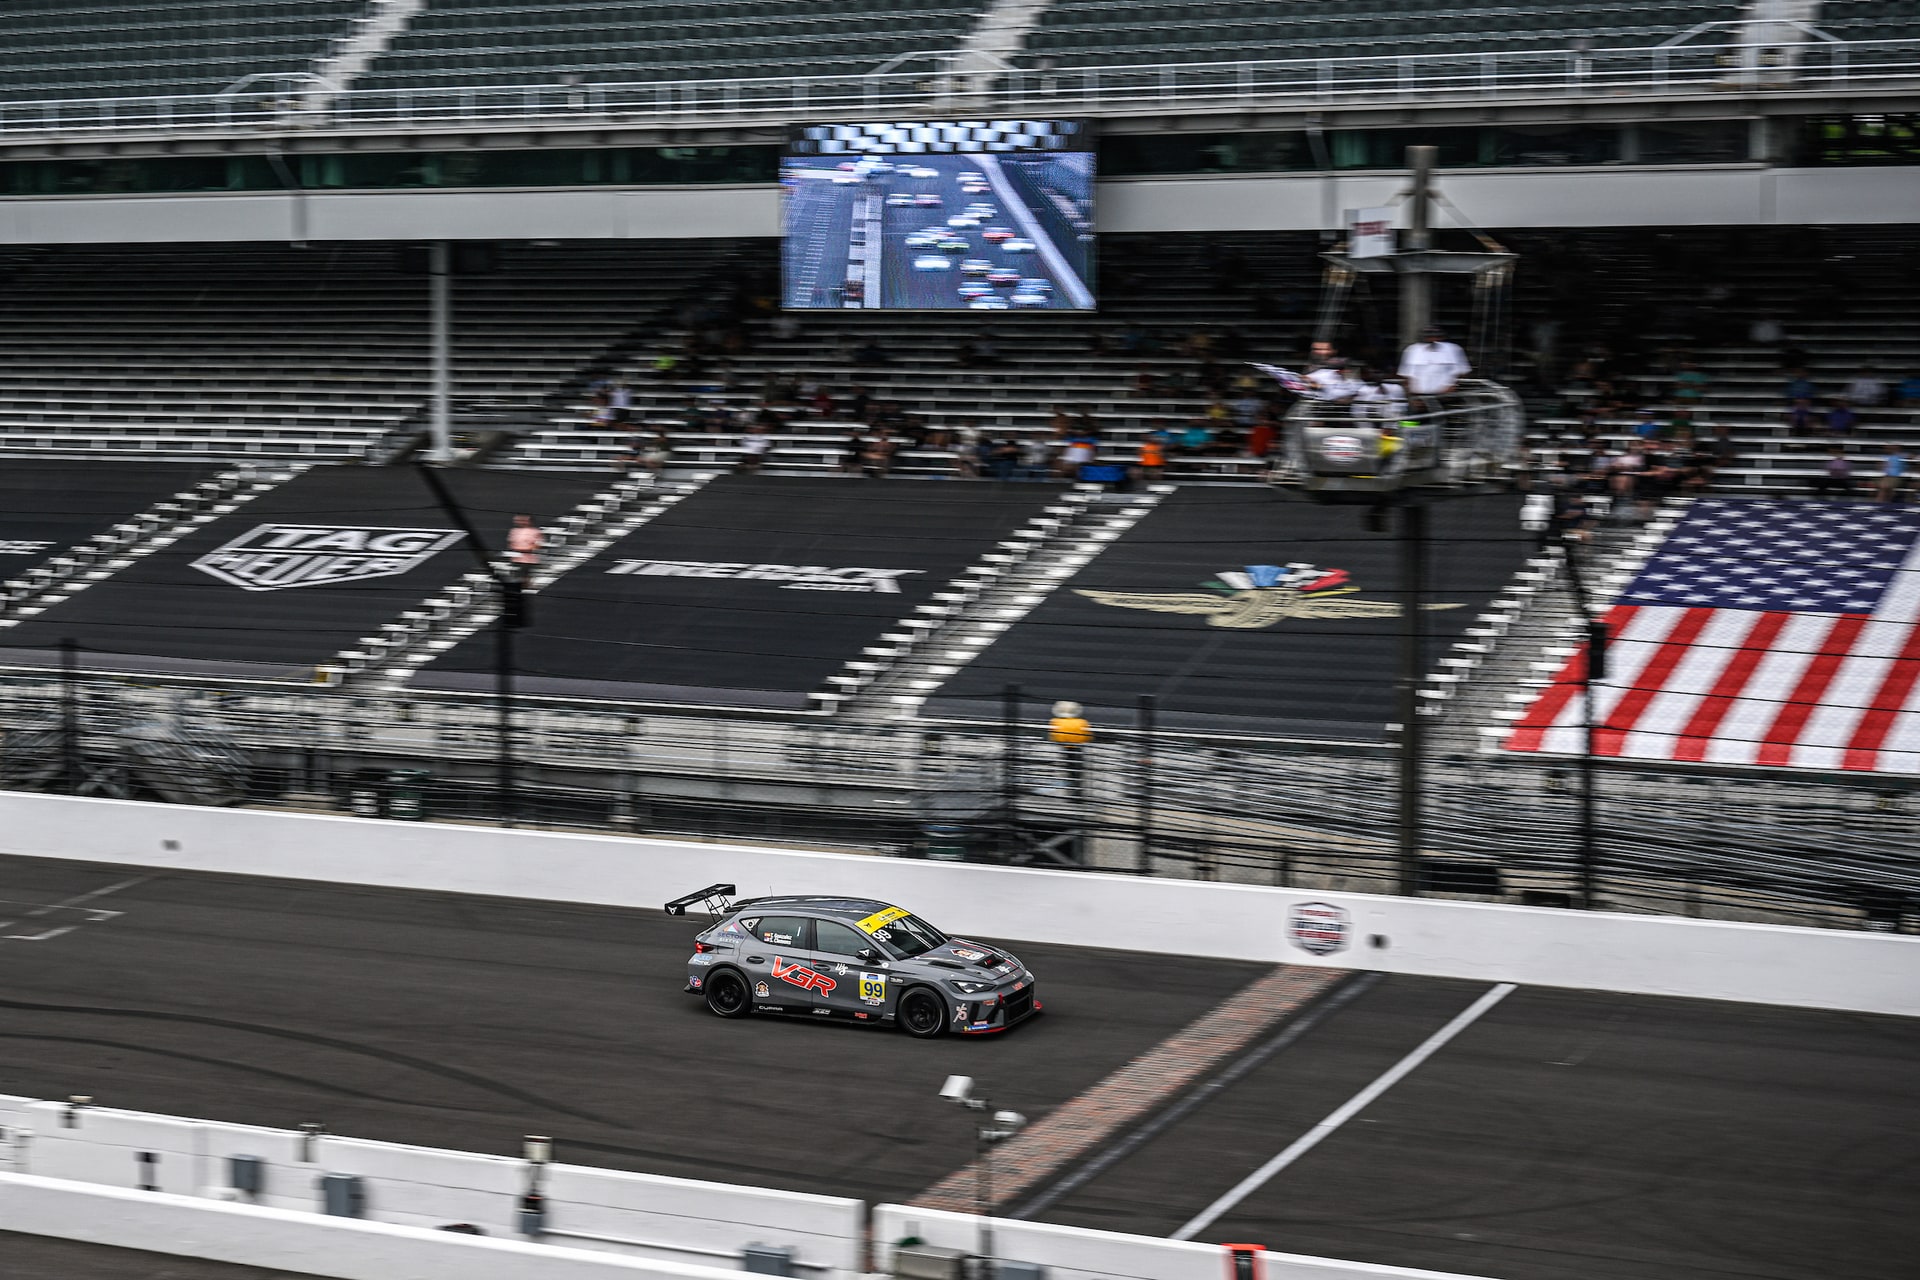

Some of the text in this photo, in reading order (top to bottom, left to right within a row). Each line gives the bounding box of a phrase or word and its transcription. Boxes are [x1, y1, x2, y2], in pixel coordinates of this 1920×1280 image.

[263, 528, 444, 552] TAG
[207, 553, 411, 584] HEUER
[717, 931, 745, 940] SECTOR
[872, 929, 892, 943] 99
[771, 955, 838, 998] VGR
[864, 982, 883, 997] 99
